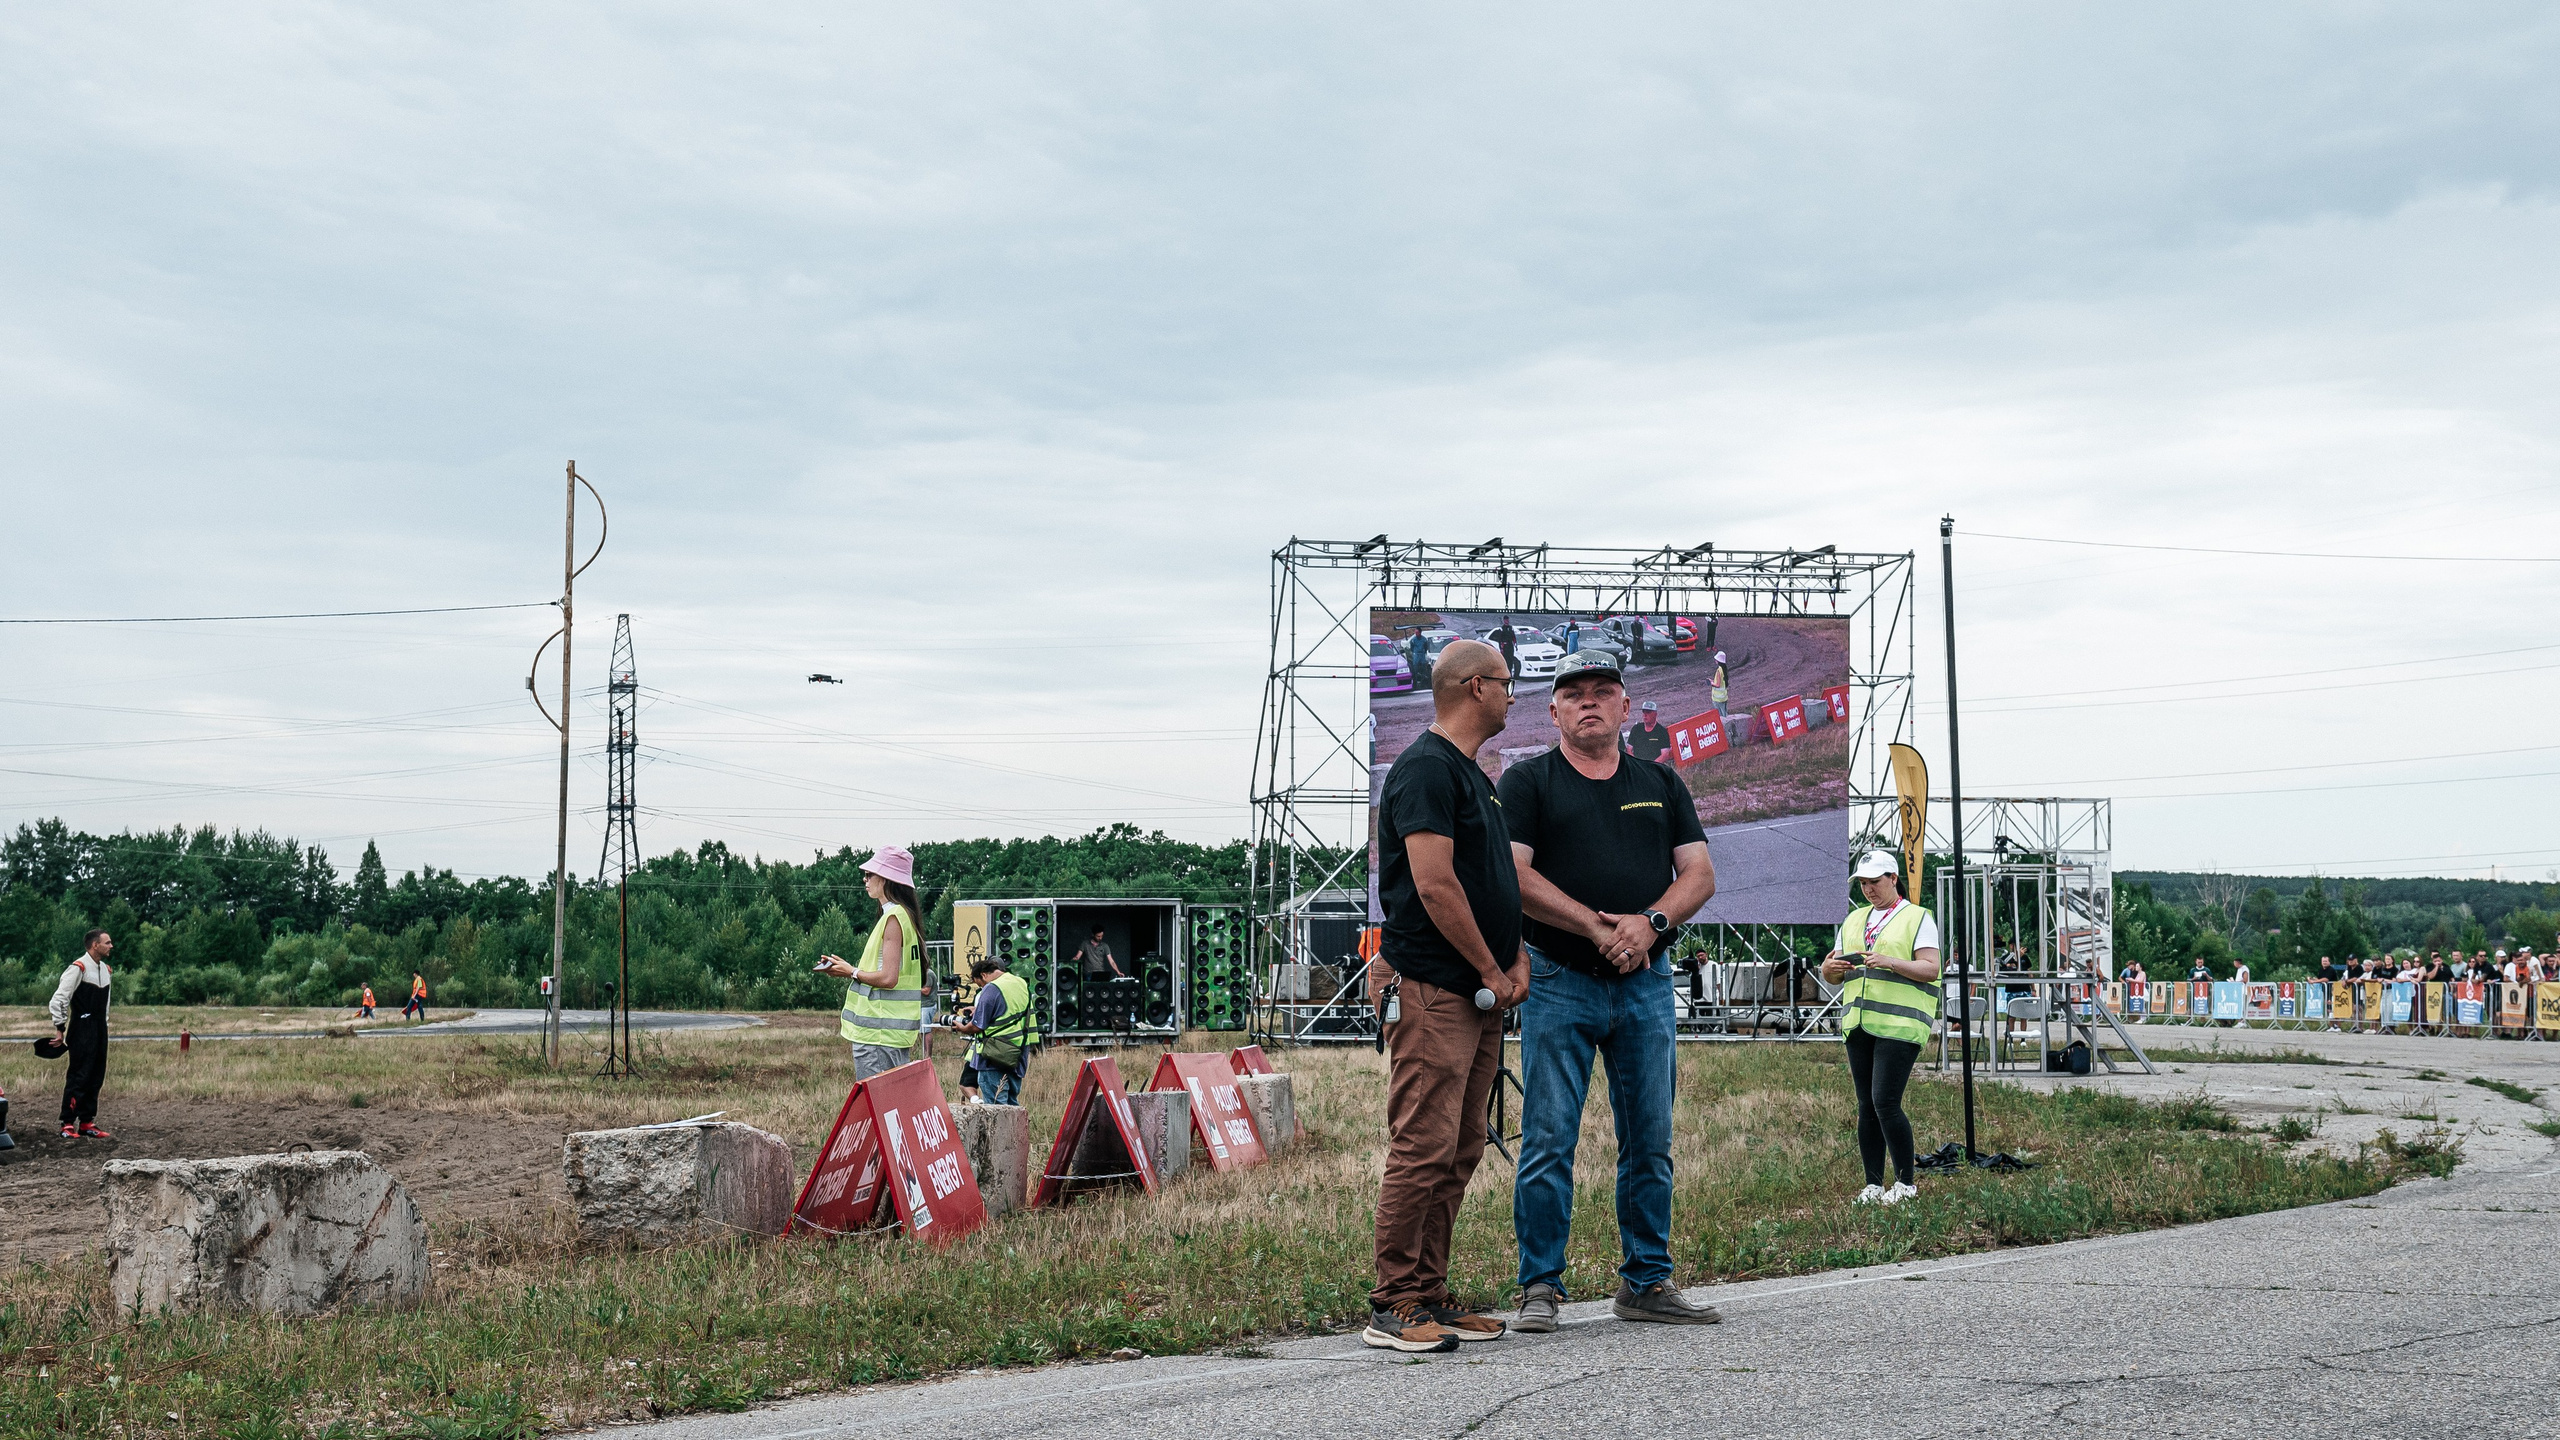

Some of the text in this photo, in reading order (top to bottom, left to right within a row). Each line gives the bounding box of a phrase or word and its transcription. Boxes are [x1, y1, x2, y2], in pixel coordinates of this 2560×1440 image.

[1695, 721, 1717, 738] РАДИО
[1698, 732, 1720, 750] ENERGY
[1210, 1084, 1242, 1115] РАДИО
[912, 1105, 950, 1153] РАДИО
[1223, 1117, 1255, 1146] ENERGY
[926, 1151, 965, 1201] ENERGY
